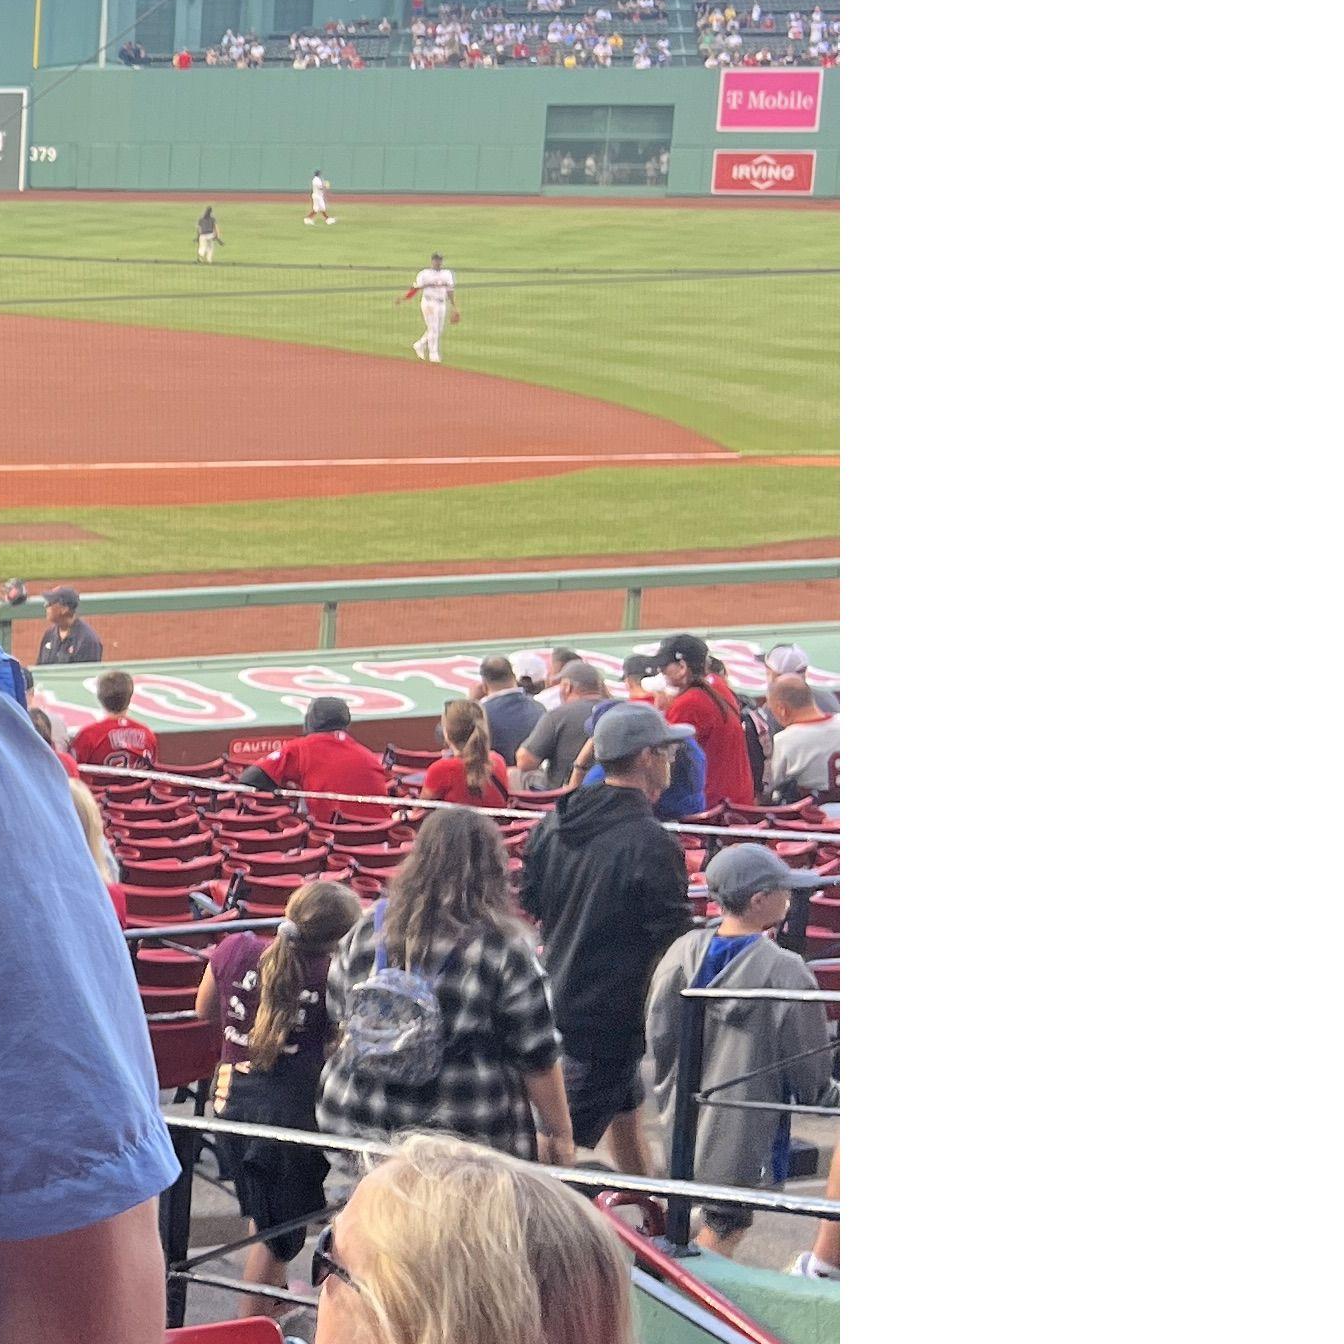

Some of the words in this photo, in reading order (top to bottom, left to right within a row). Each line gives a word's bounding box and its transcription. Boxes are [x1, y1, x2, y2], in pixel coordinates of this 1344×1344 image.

[748, 90, 813, 111] Mobile
[29, 146, 57, 163] 379
[731, 163, 795, 181] IRVING
